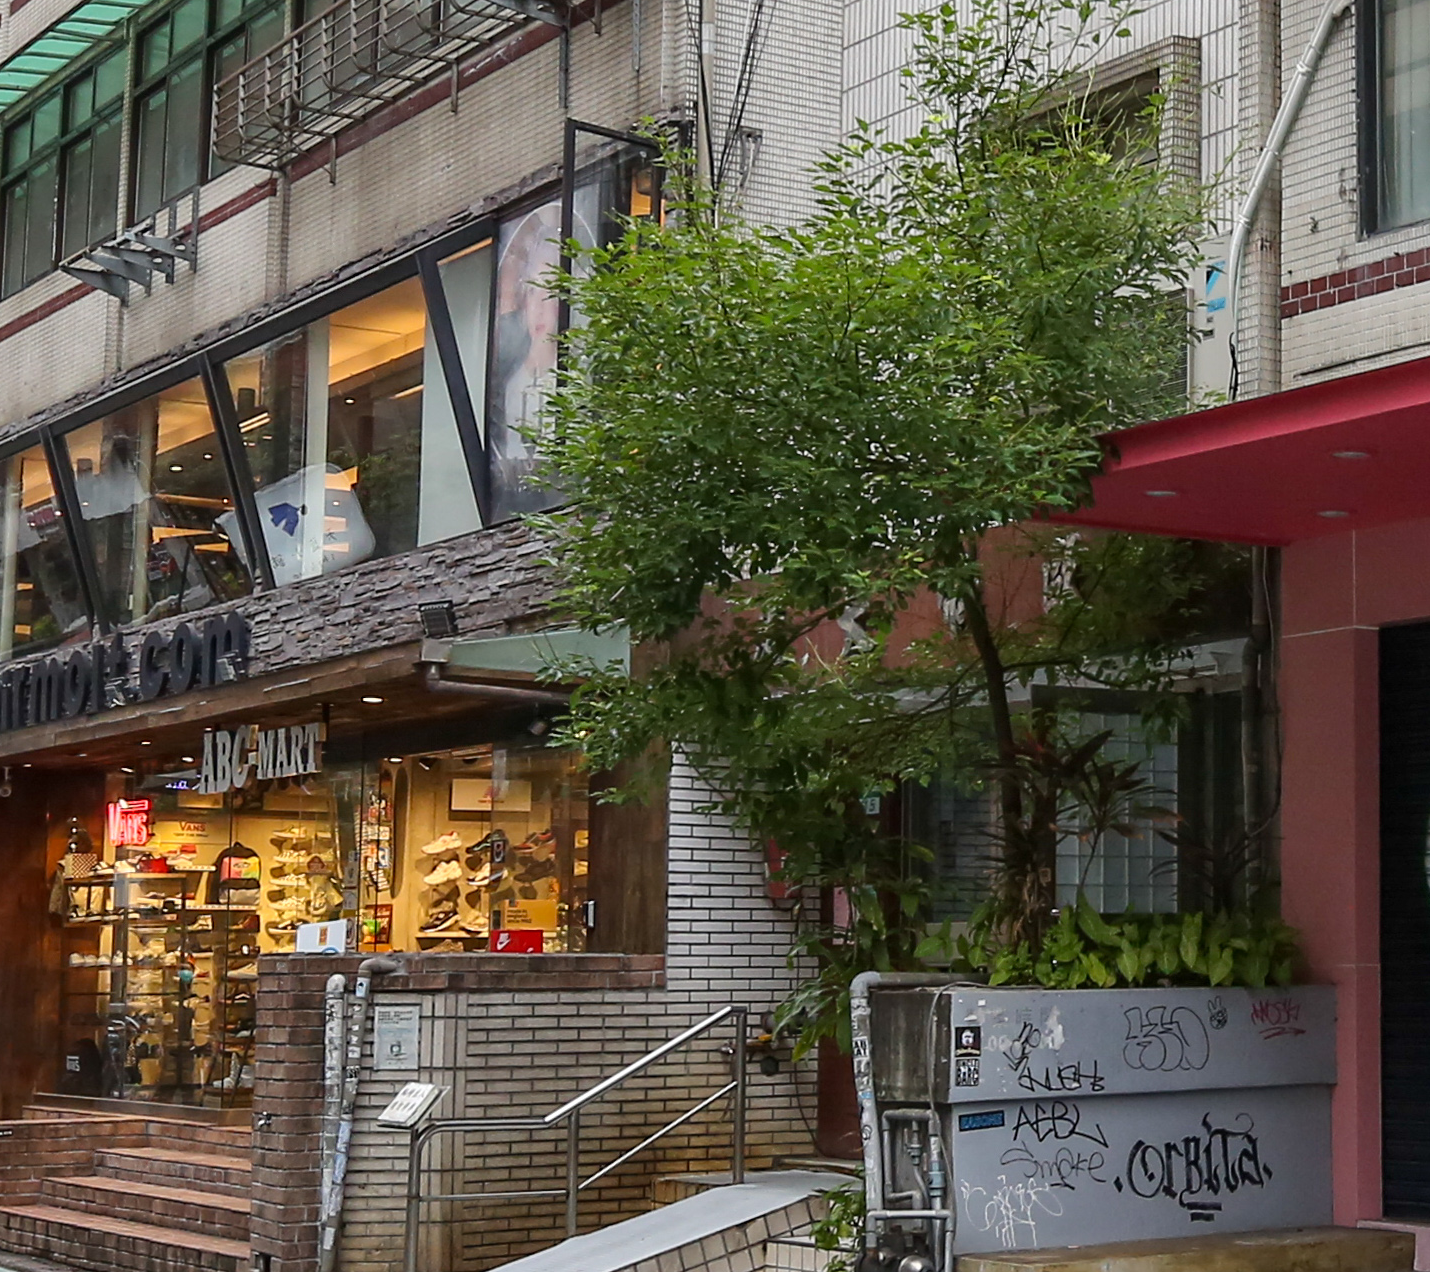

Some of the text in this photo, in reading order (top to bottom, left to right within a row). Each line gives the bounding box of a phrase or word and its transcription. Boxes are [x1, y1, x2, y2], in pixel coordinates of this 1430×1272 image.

[198, 723, 324, 795] ABC-MART
[108, 799, 151, 847] VANS
[179, 821, 206, 832] VANS
